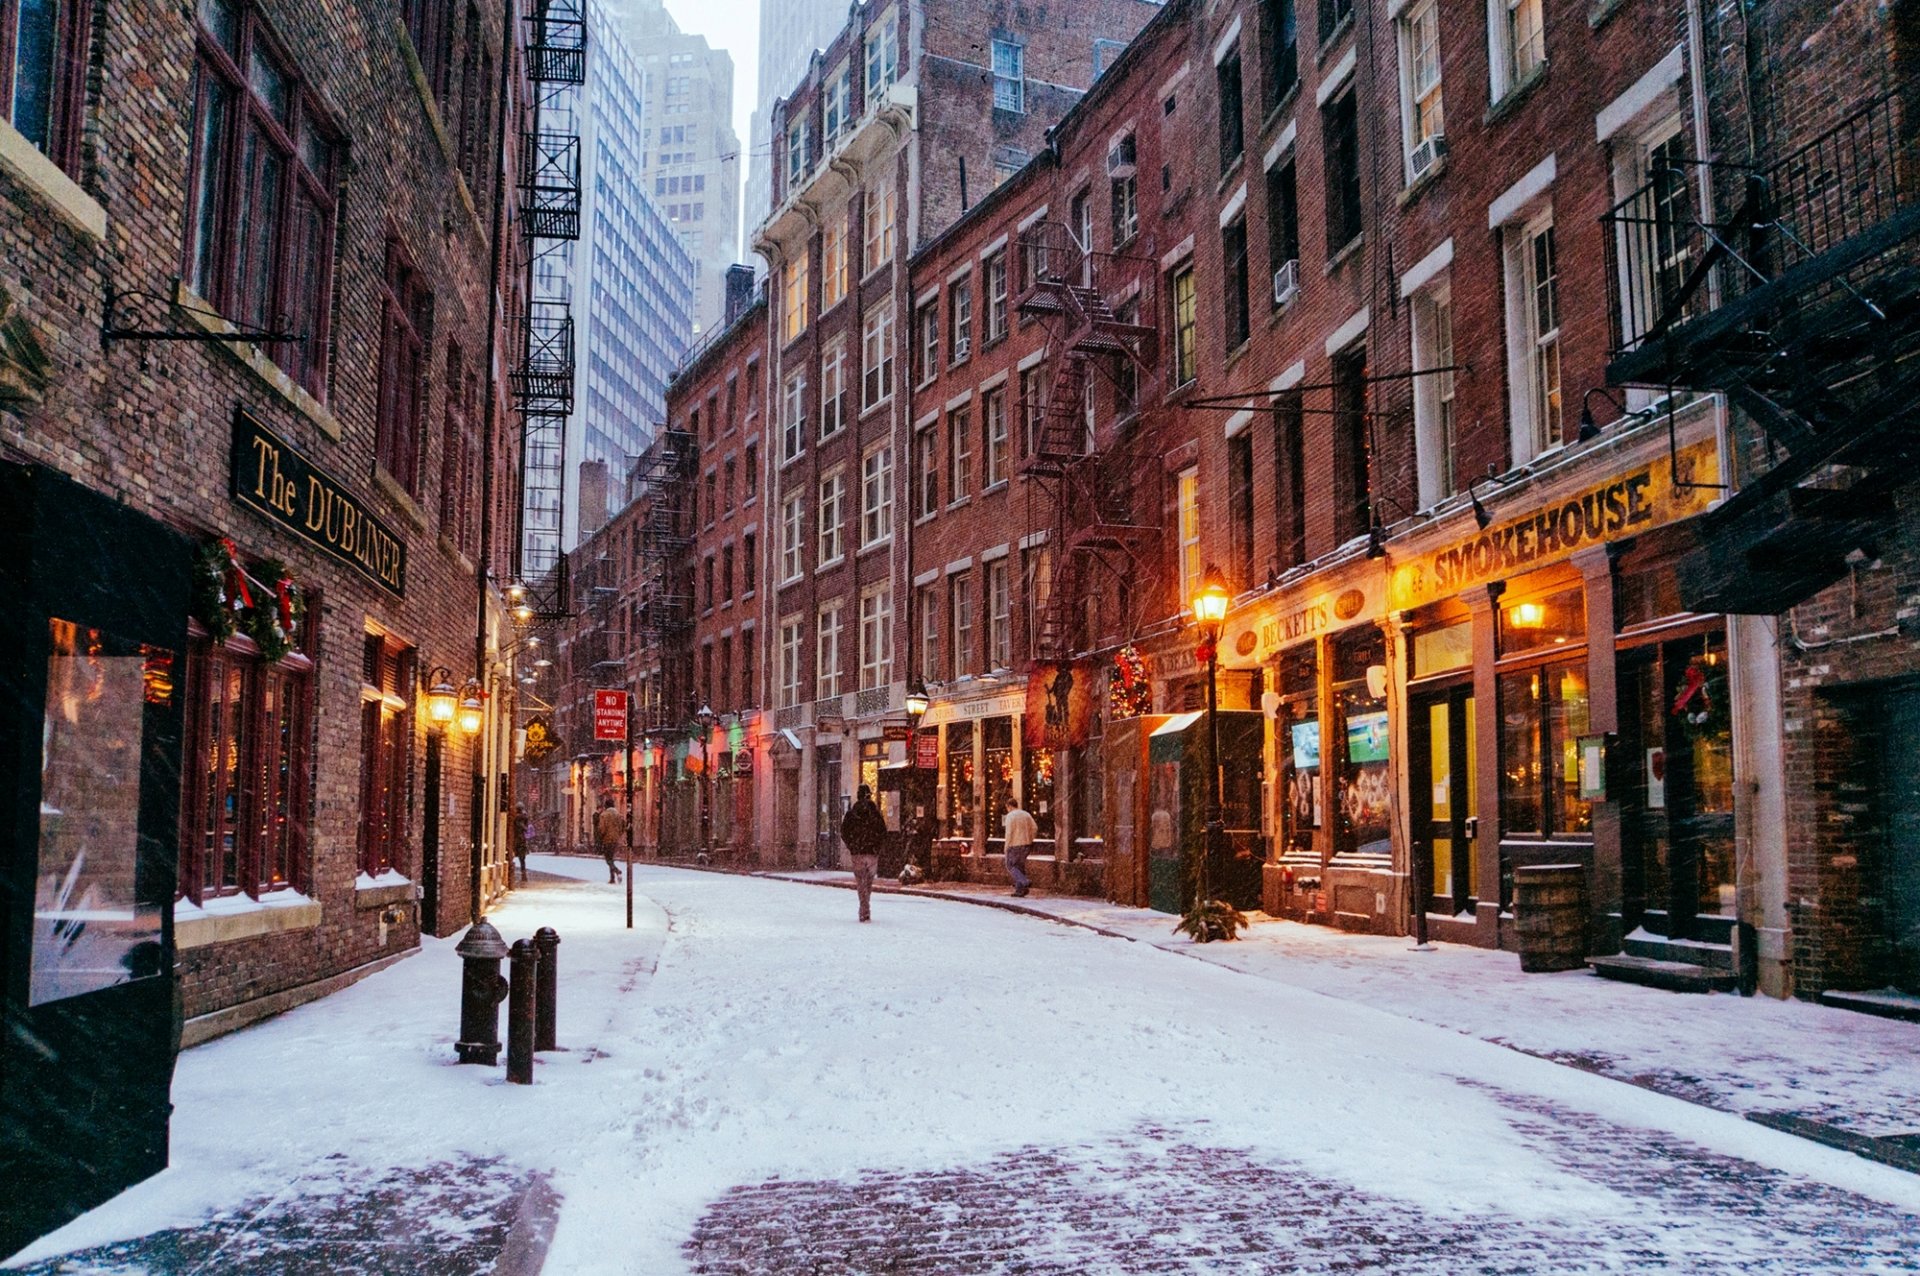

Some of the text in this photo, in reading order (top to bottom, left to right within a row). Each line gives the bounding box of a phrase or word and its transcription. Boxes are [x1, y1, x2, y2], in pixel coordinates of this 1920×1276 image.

[253, 434, 400, 589] The DUBLINER
[1434, 471, 1652, 592] SMOKEHOUSE
[1412, 574, 1423, 593] 66
[1262, 601, 1328, 649] BECKETT'S
[605, 695, 617, 706] NO
[596, 708, 625, 718] STANDING
[963, 702, 989, 716] STREET
[598, 719, 624, 727] ANYTIME
